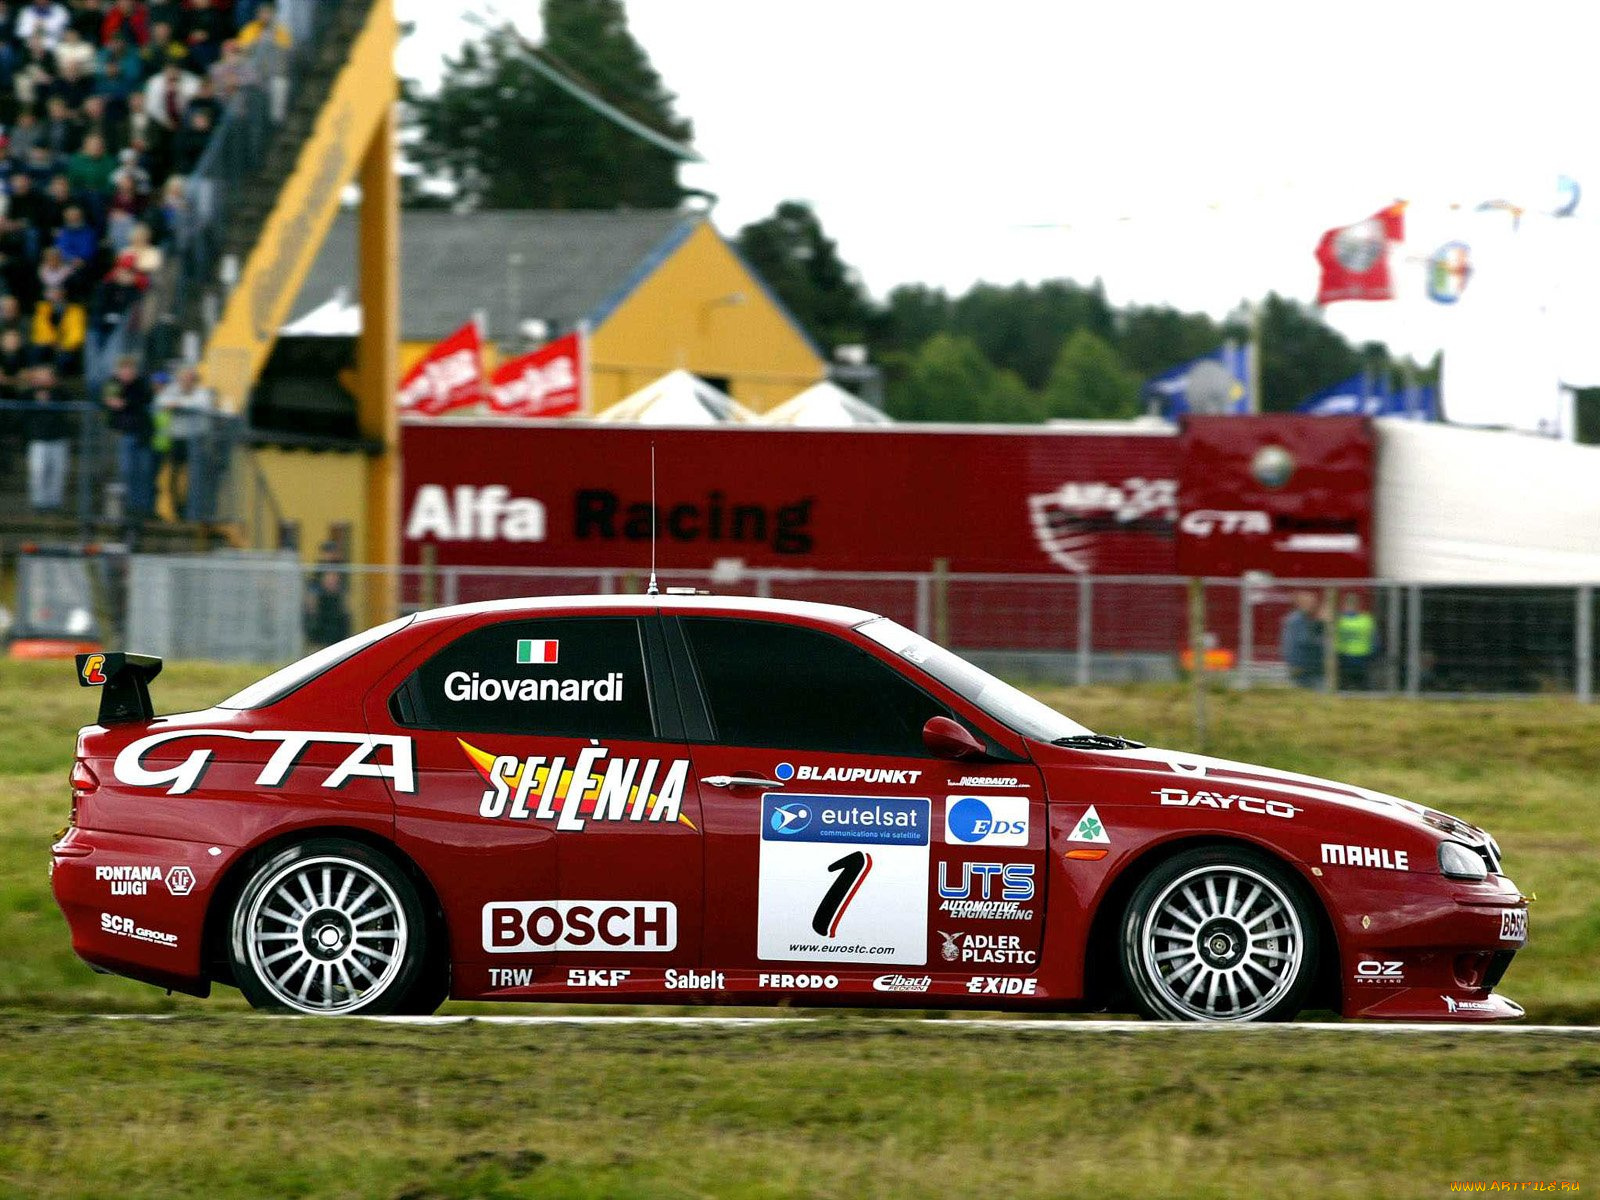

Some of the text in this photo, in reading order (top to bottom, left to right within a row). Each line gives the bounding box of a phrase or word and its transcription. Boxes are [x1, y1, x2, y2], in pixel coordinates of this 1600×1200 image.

[407, 484, 815, 555] Alfa Racing
[444, 671, 624, 702] Giovanardi
[113, 729, 417, 795] GTA
[796, 765, 922, 784] BLAUPUNKT
[1158, 788, 1296, 818] DAYCO
[821, 806, 917, 827] eutelsat
[820, 830, 878, 838] communications
[970, 819, 1026, 834] EDS
[1321, 843, 1409, 871] MAHLE
[95, 866, 163, 881] FONTANA
[938, 861, 1035, 901] UTS
[111, 881, 148, 895] LUIGI
[812, 851, 873, 938] 1
[939, 900, 1019, 912] AUTOMOTIVE
[950, 909, 1034, 920] ENGINEERING
[101, 912, 135, 933] SCR
[135, 927, 178, 943] GROUP
[491, 907, 667, 947] BOSCH
[789, 942, 895, 955] www.eurostc.com
[963, 935, 1021, 949] ADLER
[962, 949, 1036, 964] PLASTIC
[488, 968, 533, 986] TRW
[567, 969, 630, 987] SKF
[664, 968, 725, 990] Sabelt
[758, 973, 839, 989] FERODO
[872, 974, 932, 991] Eibach
[966, 976, 1038, 995] EXIDE
